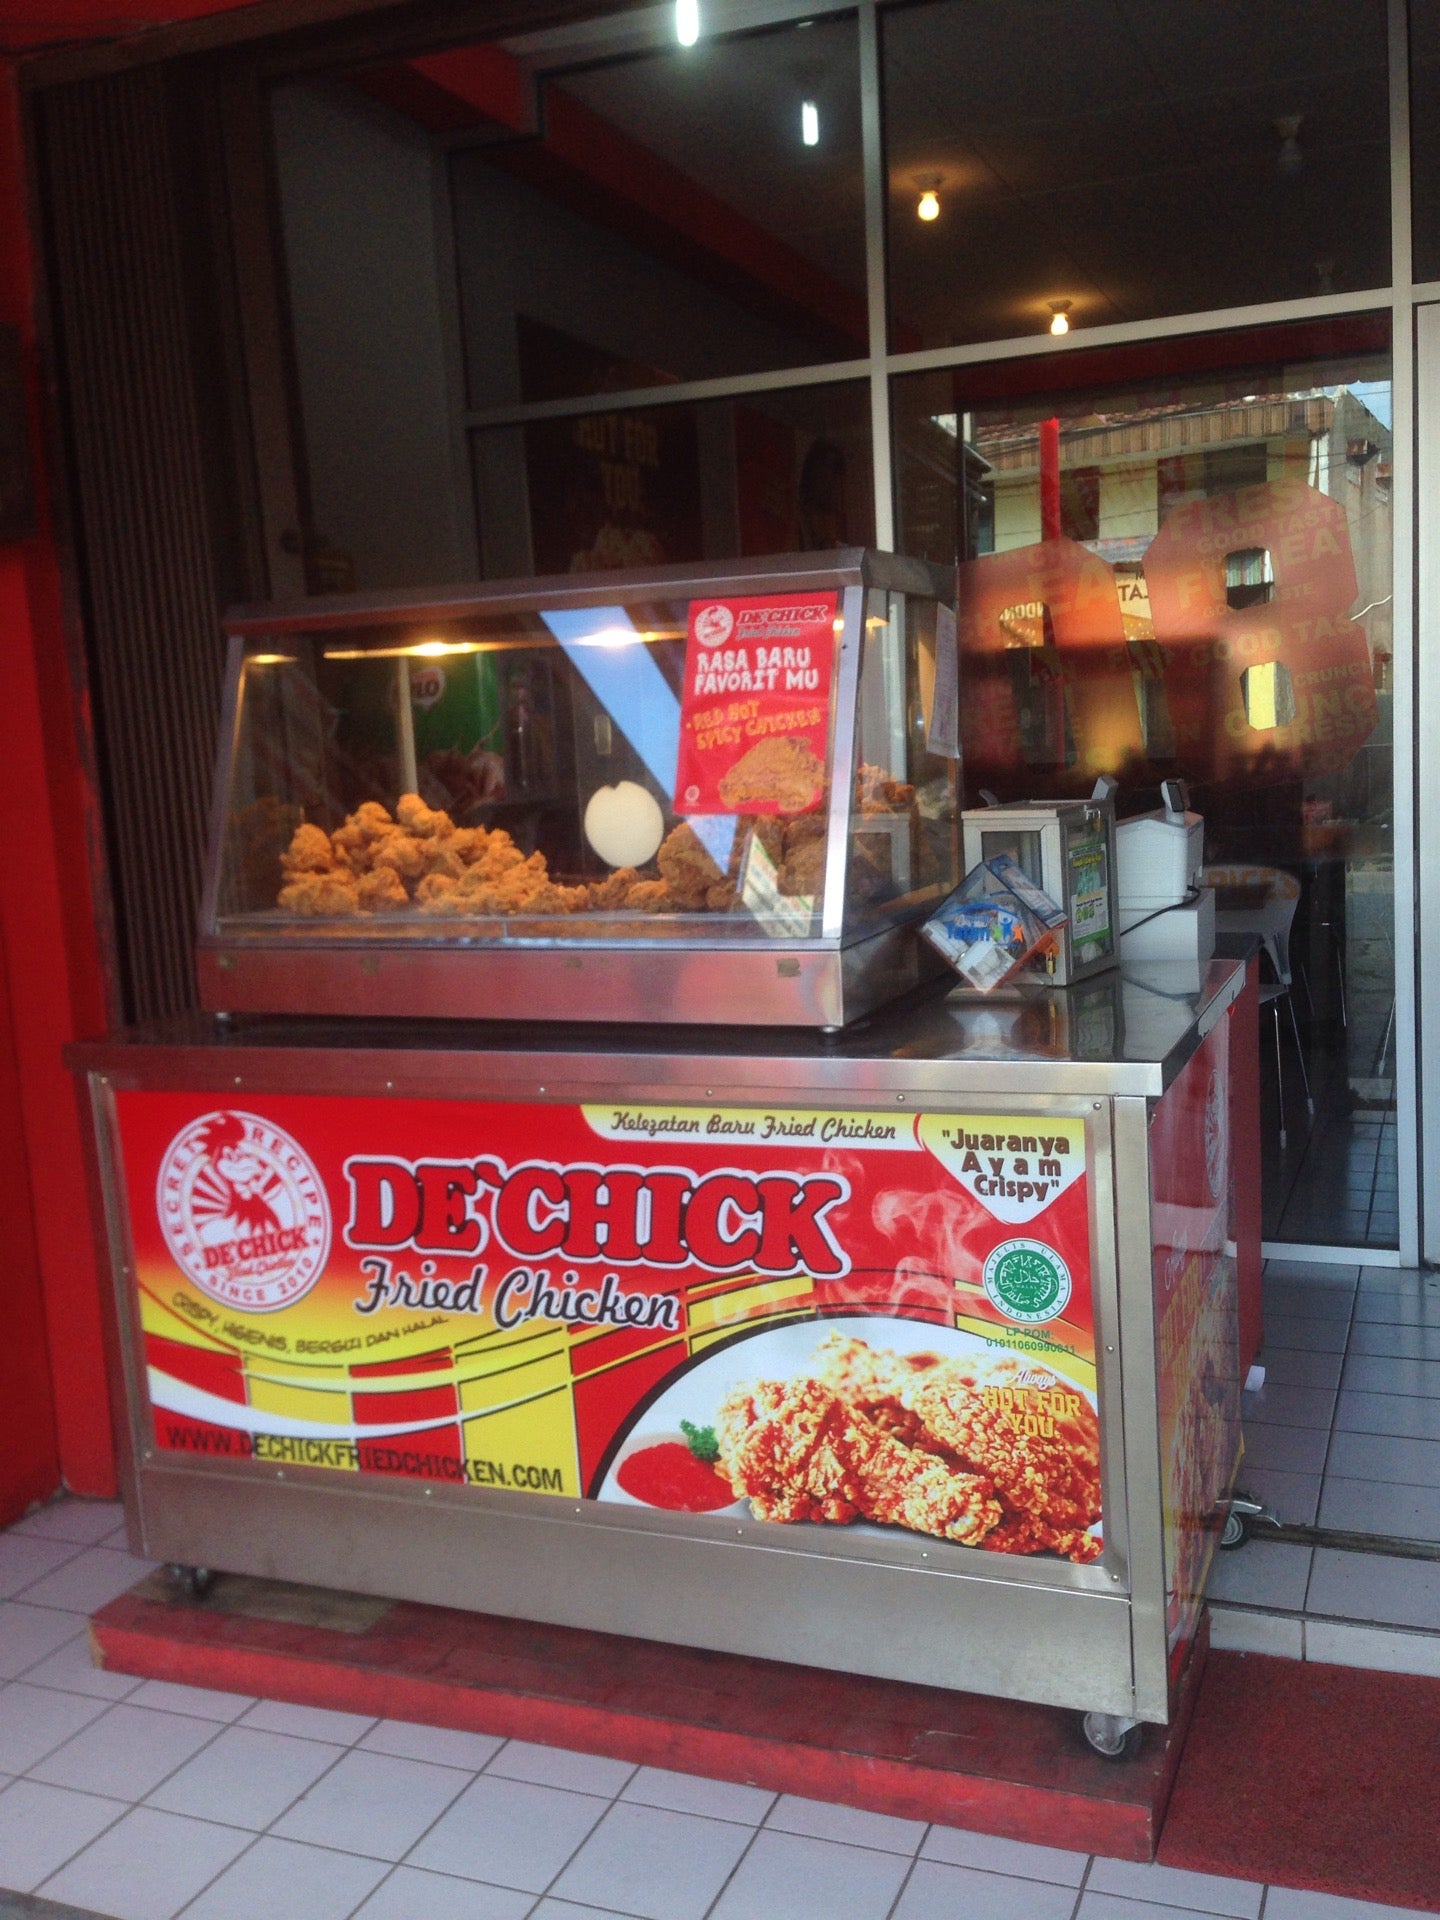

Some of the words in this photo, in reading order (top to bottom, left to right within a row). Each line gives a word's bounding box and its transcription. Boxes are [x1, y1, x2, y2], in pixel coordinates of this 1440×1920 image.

[697, 649, 748, 674] RASA
[755, 647, 812, 671] BARU
[694, 668, 780, 696] FAVORIT
[786, 668, 819, 691] MU
[696, 724, 743, 750] SPICY
[611, 1111, 700, 1134] Kelezatan
[706, 1114, 755, 1136] Baru
[760, 1116, 816, 1140] Fried
[820, 1118, 897, 1142] Chicken
[942, 1128, 1071, 1157] "Juaranya
[973, 1174, 1060, 1203] Crispy"
[343, 1155, 850, 1279] DE'CHICK
[354, 1256, 487, 1314] Fried
[492, 1262, 680, 1332] Chicken
[366, 1326, 400, 1348] DAN
[402, 1314, 449, 1335] HALAL
[1009, 1368, 1058, 1390] Always
[983, 1385, 1030, 1412] HOT
[1036, 1389, 1083, 1418] FOR
[1009, 1412, 1055, 1439] YOU
[166, 1424, 565, 1493] WWW.DECHICKFRIEDCHICKEN.COM
